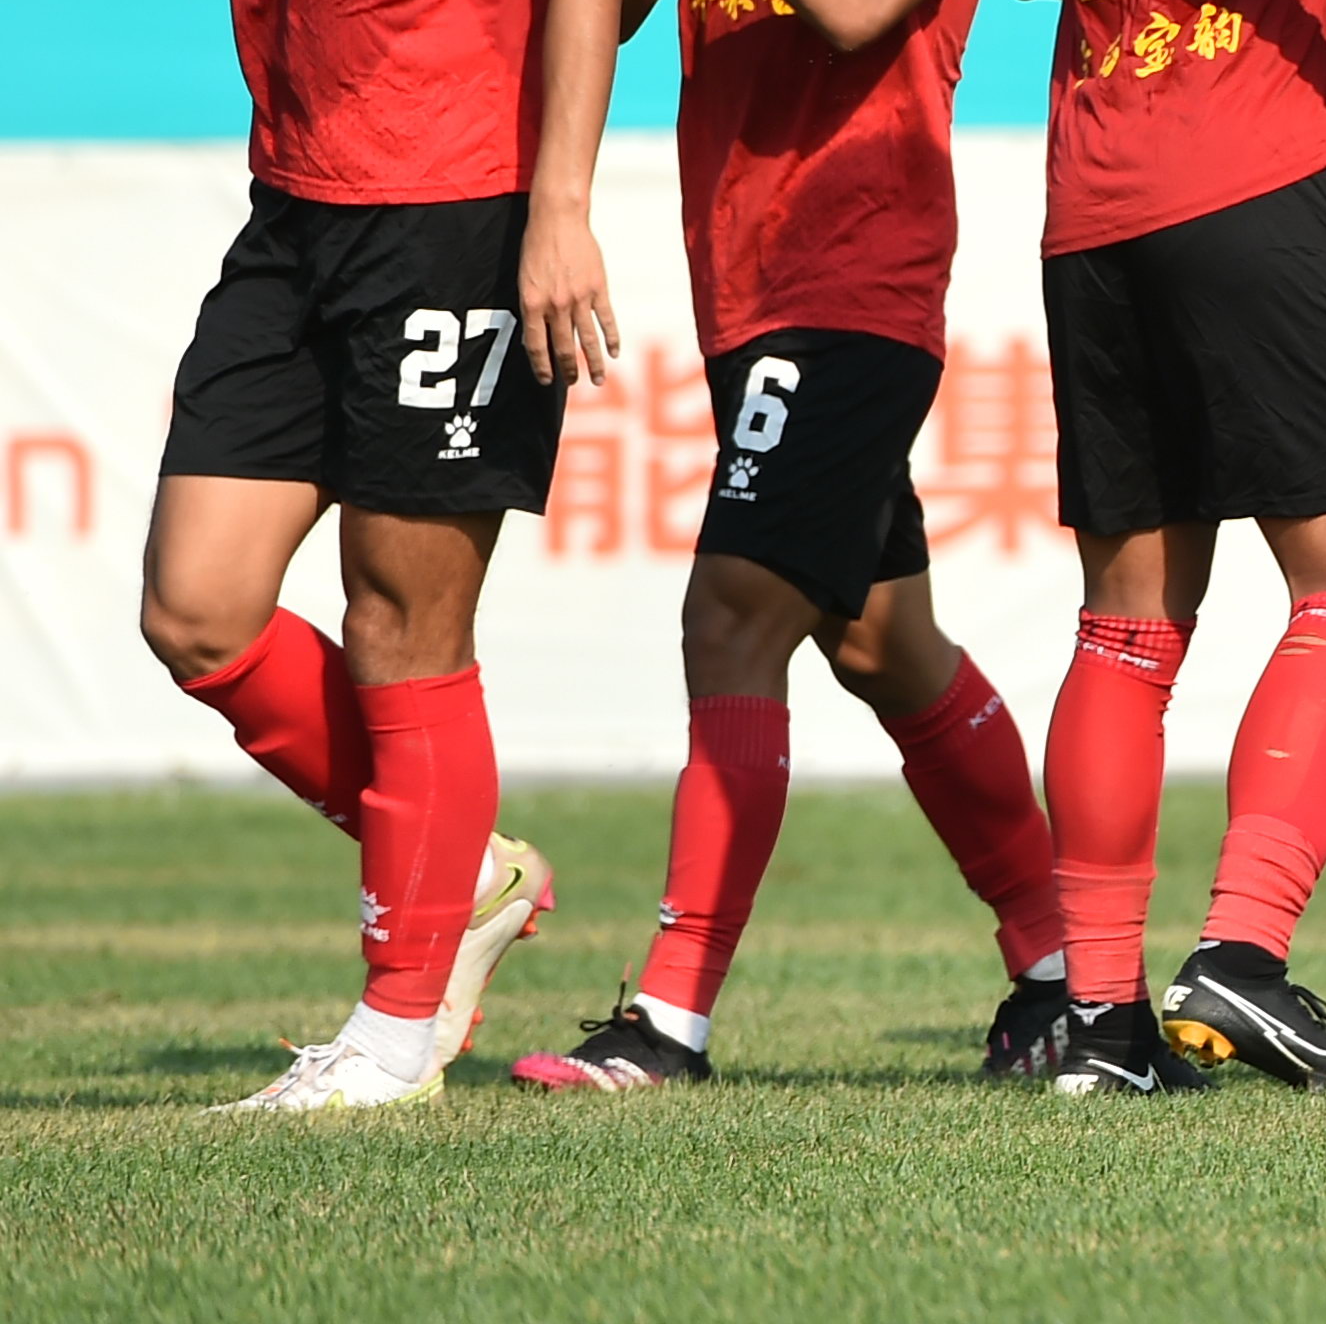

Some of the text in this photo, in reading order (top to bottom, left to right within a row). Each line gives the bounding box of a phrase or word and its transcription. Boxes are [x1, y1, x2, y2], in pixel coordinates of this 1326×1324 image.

[398, 308, 517, 409] 27
[733, 355, 801, 453] 6
[437, 446, 480, 460] KELME
